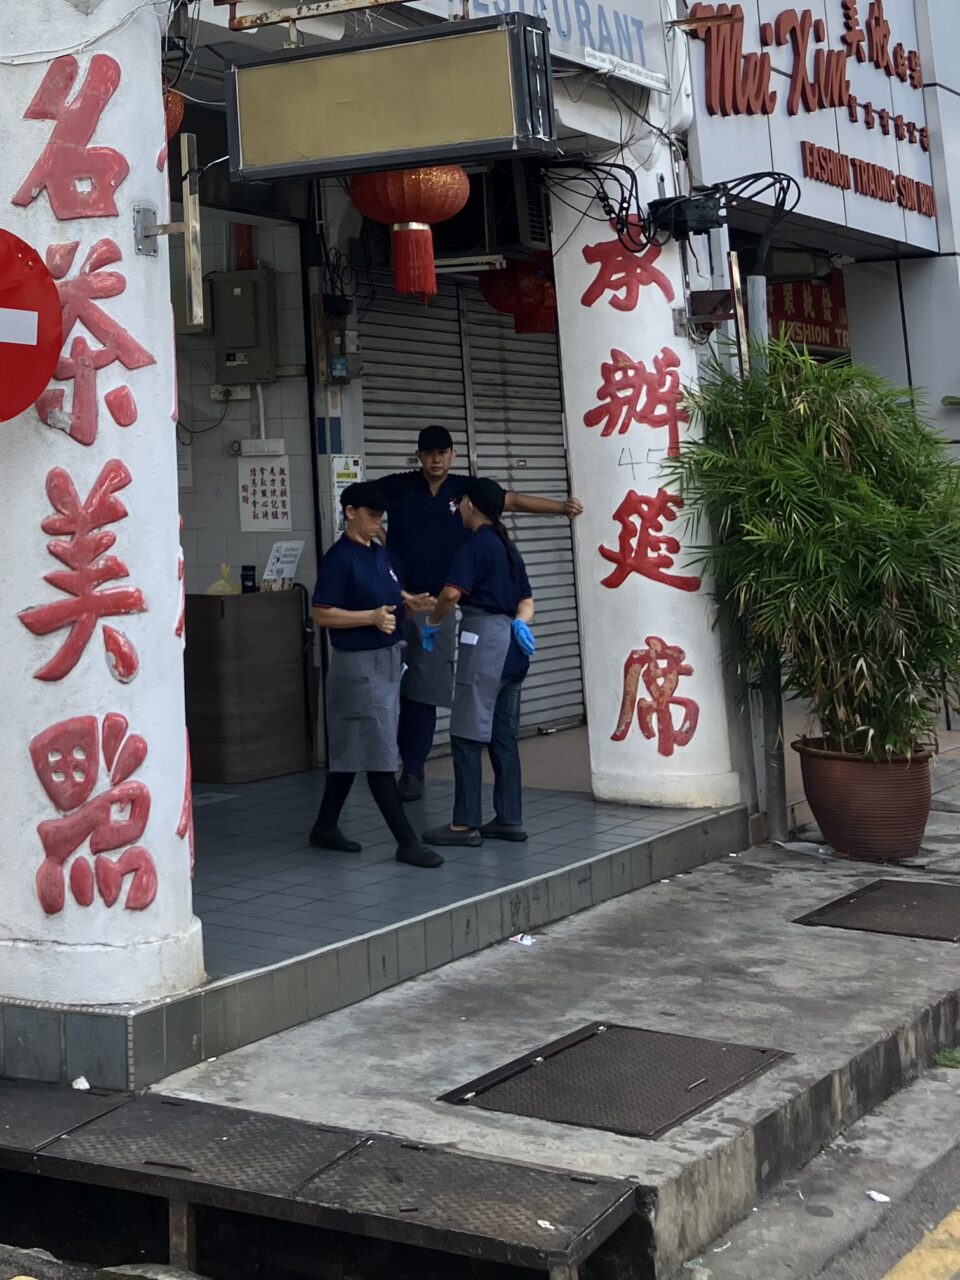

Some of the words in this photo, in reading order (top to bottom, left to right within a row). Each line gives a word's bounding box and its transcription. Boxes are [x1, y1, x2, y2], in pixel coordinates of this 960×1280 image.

[689, 1, 778, 117] Mei
[774, 8, 852, 117] Xin
[800, 140, 851, 190] FASHION
[850, 157, 897, 203] TRADING
[895, 174, 917, 211] SDN
[618, 447, 663, 480] 45
